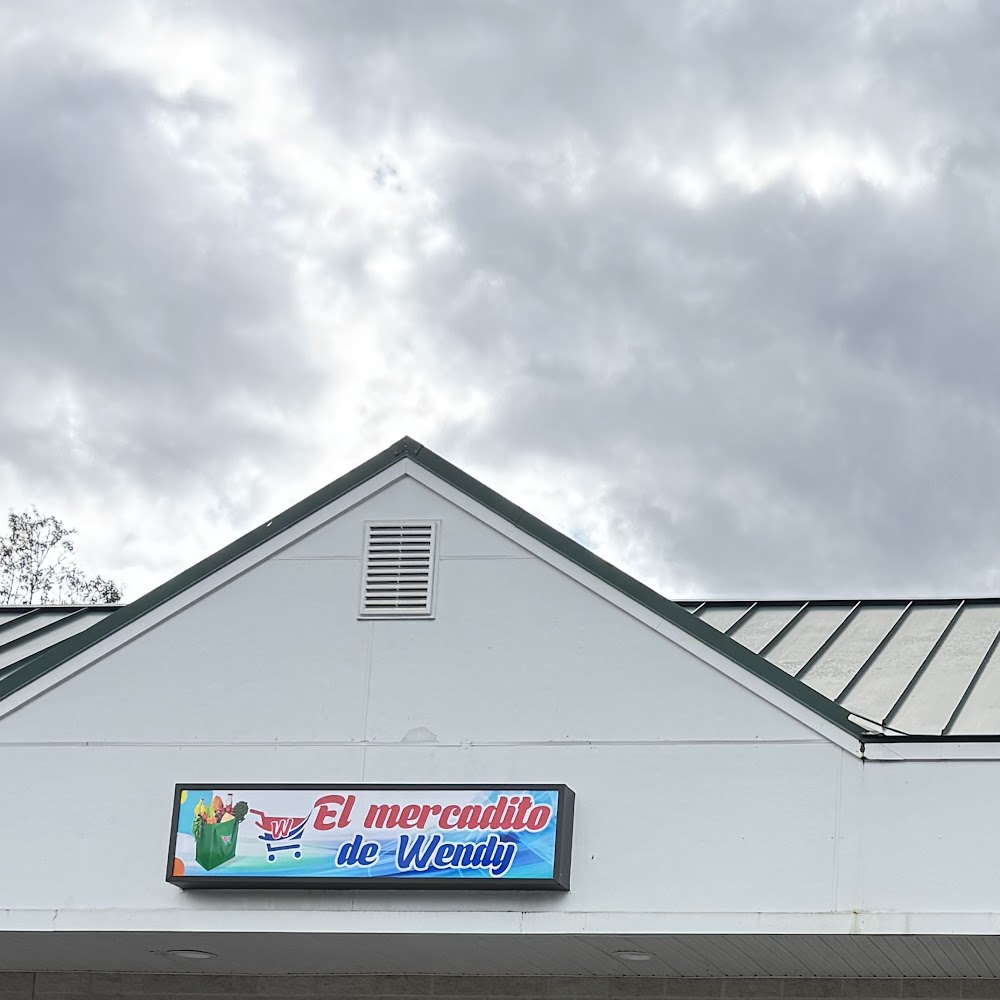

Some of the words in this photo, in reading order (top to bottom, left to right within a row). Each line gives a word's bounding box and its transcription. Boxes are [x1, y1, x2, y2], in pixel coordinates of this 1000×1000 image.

[314, 794, 356, 832] El
[364, 796, 551, 831] mercadito
[337, 835, 379, 867] de
[399, 834, 516, 877] Wendy
